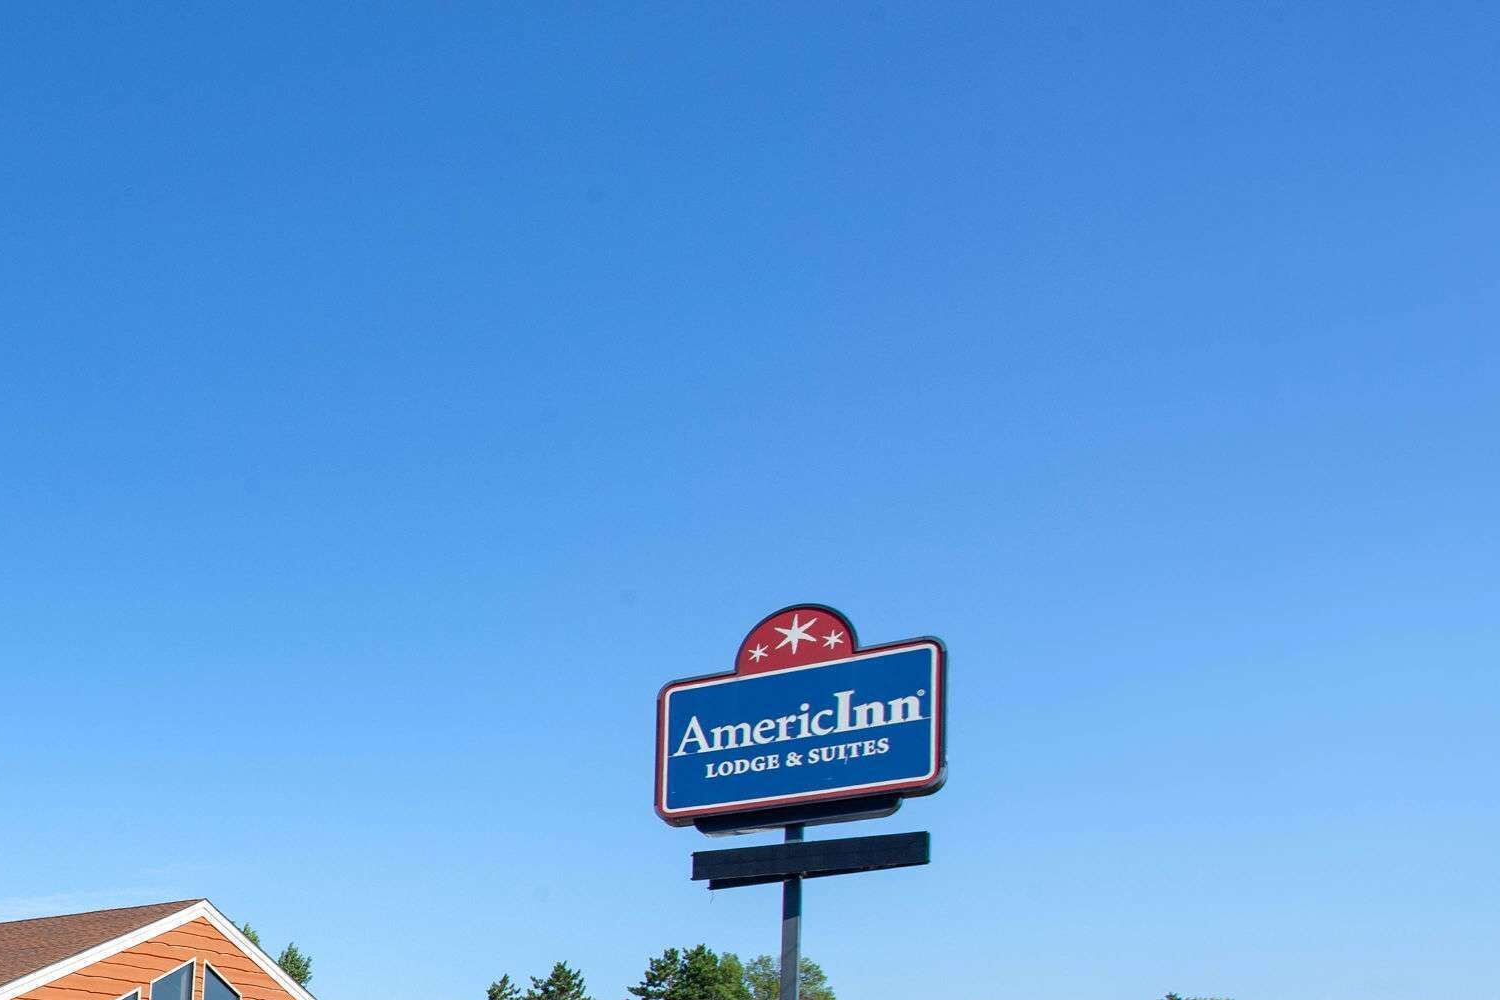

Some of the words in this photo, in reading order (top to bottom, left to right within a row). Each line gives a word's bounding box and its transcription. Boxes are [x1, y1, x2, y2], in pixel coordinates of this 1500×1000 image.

[672, 689, 923, 757] AmericInn
[705, 754, 780, 779] LODGE
[785, 751, 803, 767] &
[807, 737, 890, 765] SUITES
